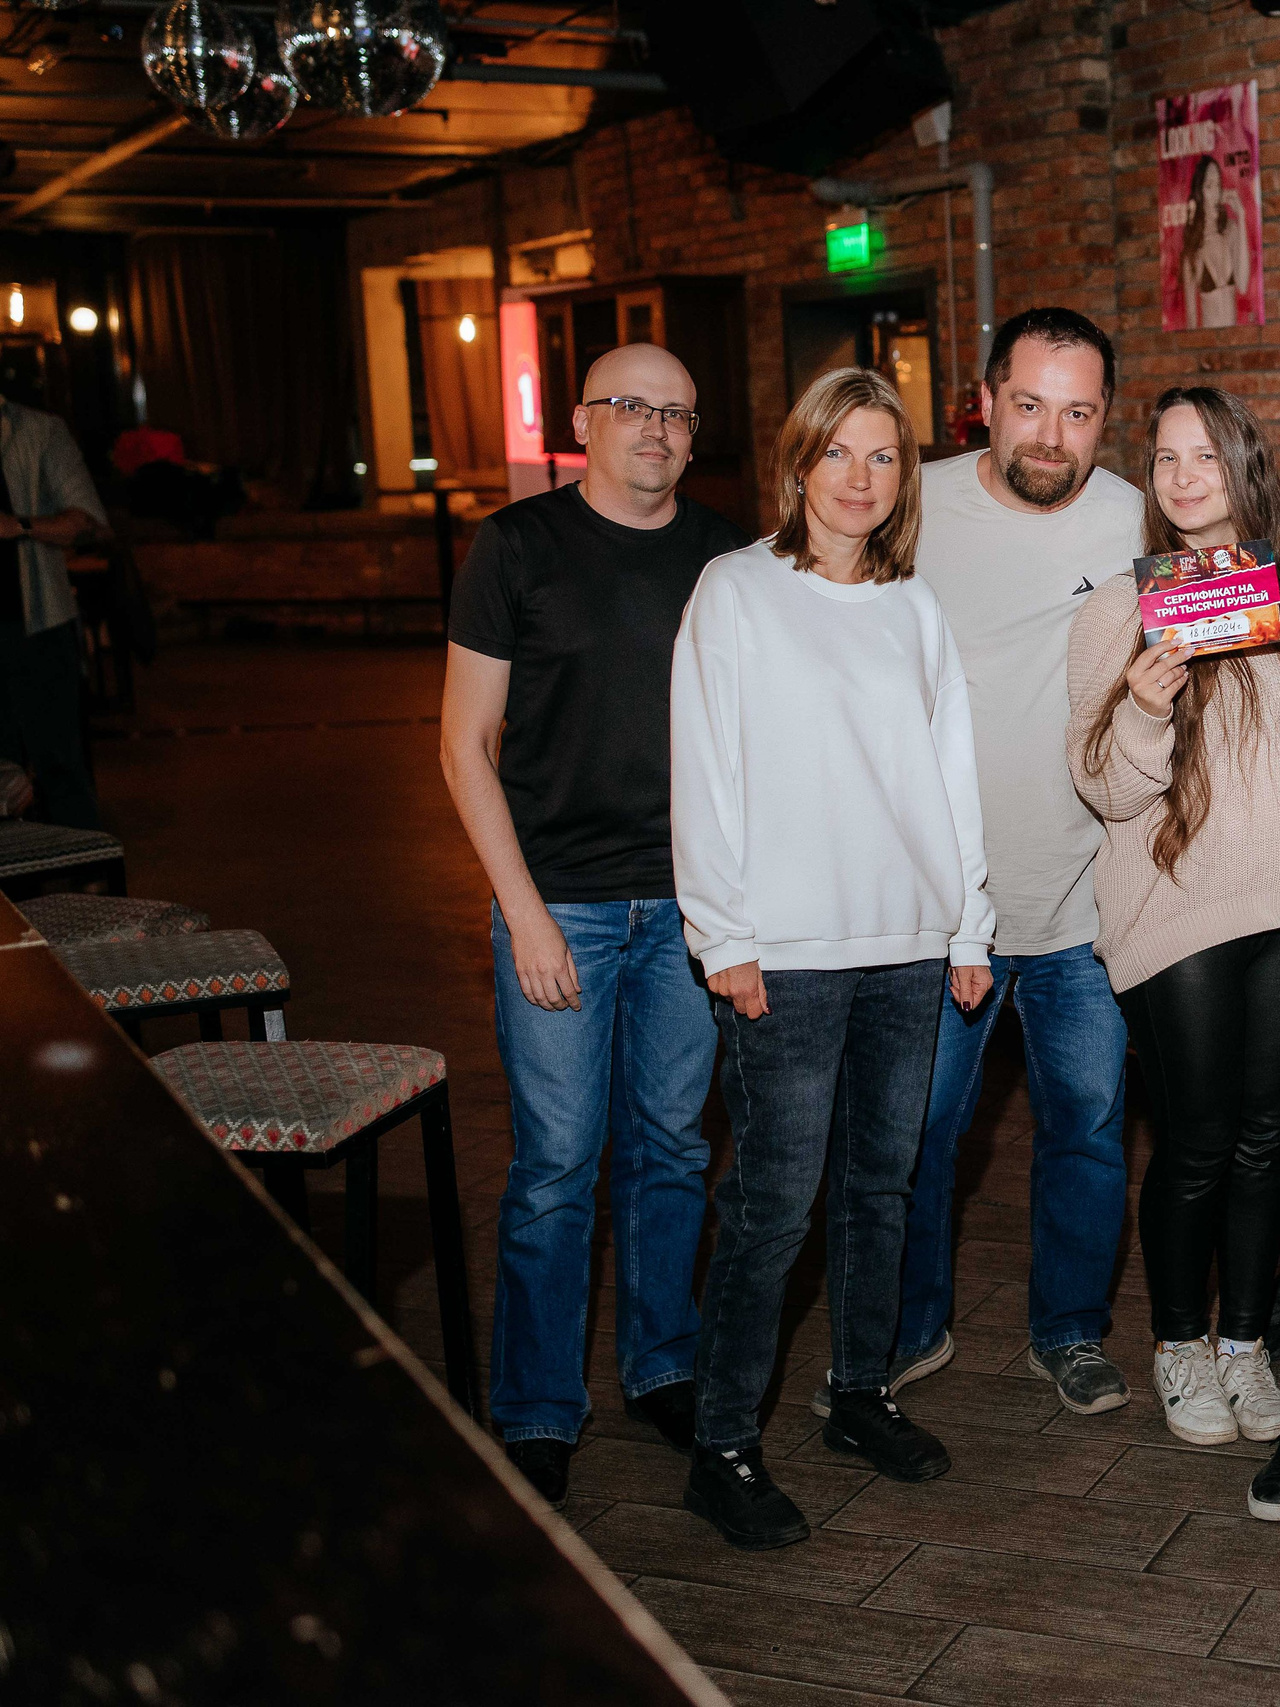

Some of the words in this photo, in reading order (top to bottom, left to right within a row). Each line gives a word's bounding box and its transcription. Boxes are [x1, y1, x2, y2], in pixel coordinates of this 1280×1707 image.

[1154, 606, 1178, 618] ТРИ
[1178, 599, 1225, 615] ТЫСЯЧИ
[1226, 590, 1269, 607] РУБЛЕЙ
[1164, 586, 1237, 605] СЕРТИФИКАТ
[1238, 584, 1255, 593] НА
